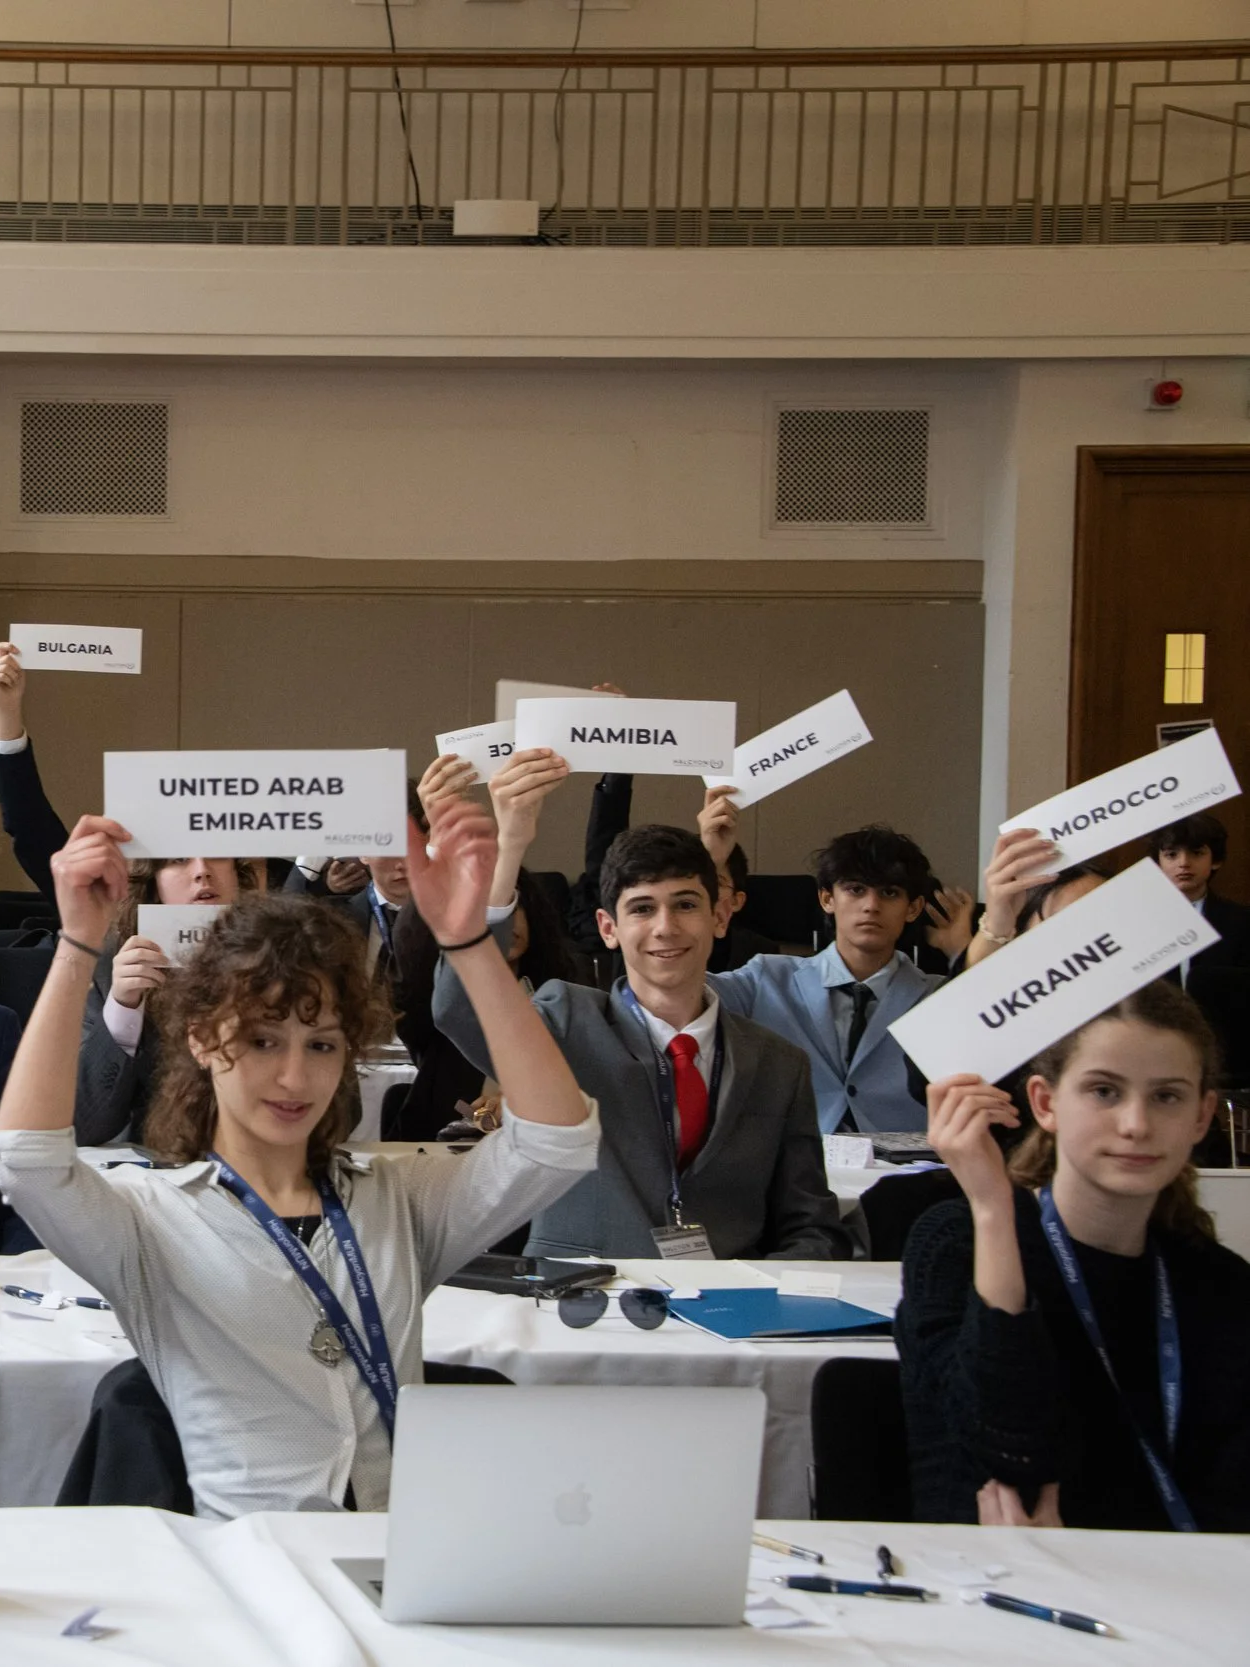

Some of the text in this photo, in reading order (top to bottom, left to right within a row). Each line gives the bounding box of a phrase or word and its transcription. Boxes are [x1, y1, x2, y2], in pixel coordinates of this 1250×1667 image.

[38, 642, 113, 656] BULGARIA
[570, 726, 679, 747] NAMIBIA
[748, 732, 820, 777] FRANCE
[158, 776, 345, 797] UNITED ARAB
[1049, 776, 1180, 841] MOROCCO
[189, 811, 324, 831] EMIRATES
[324, 834, 373, 842] HALCYON
[979, 932, 1124, 1030] UKRAINE
[267, 1218, 309, 1272] HalcyonMUN
[342, 1239, 368, 1298] HalcyonMUN
[341, 1322, 380, 1385] HalcyonMUN
